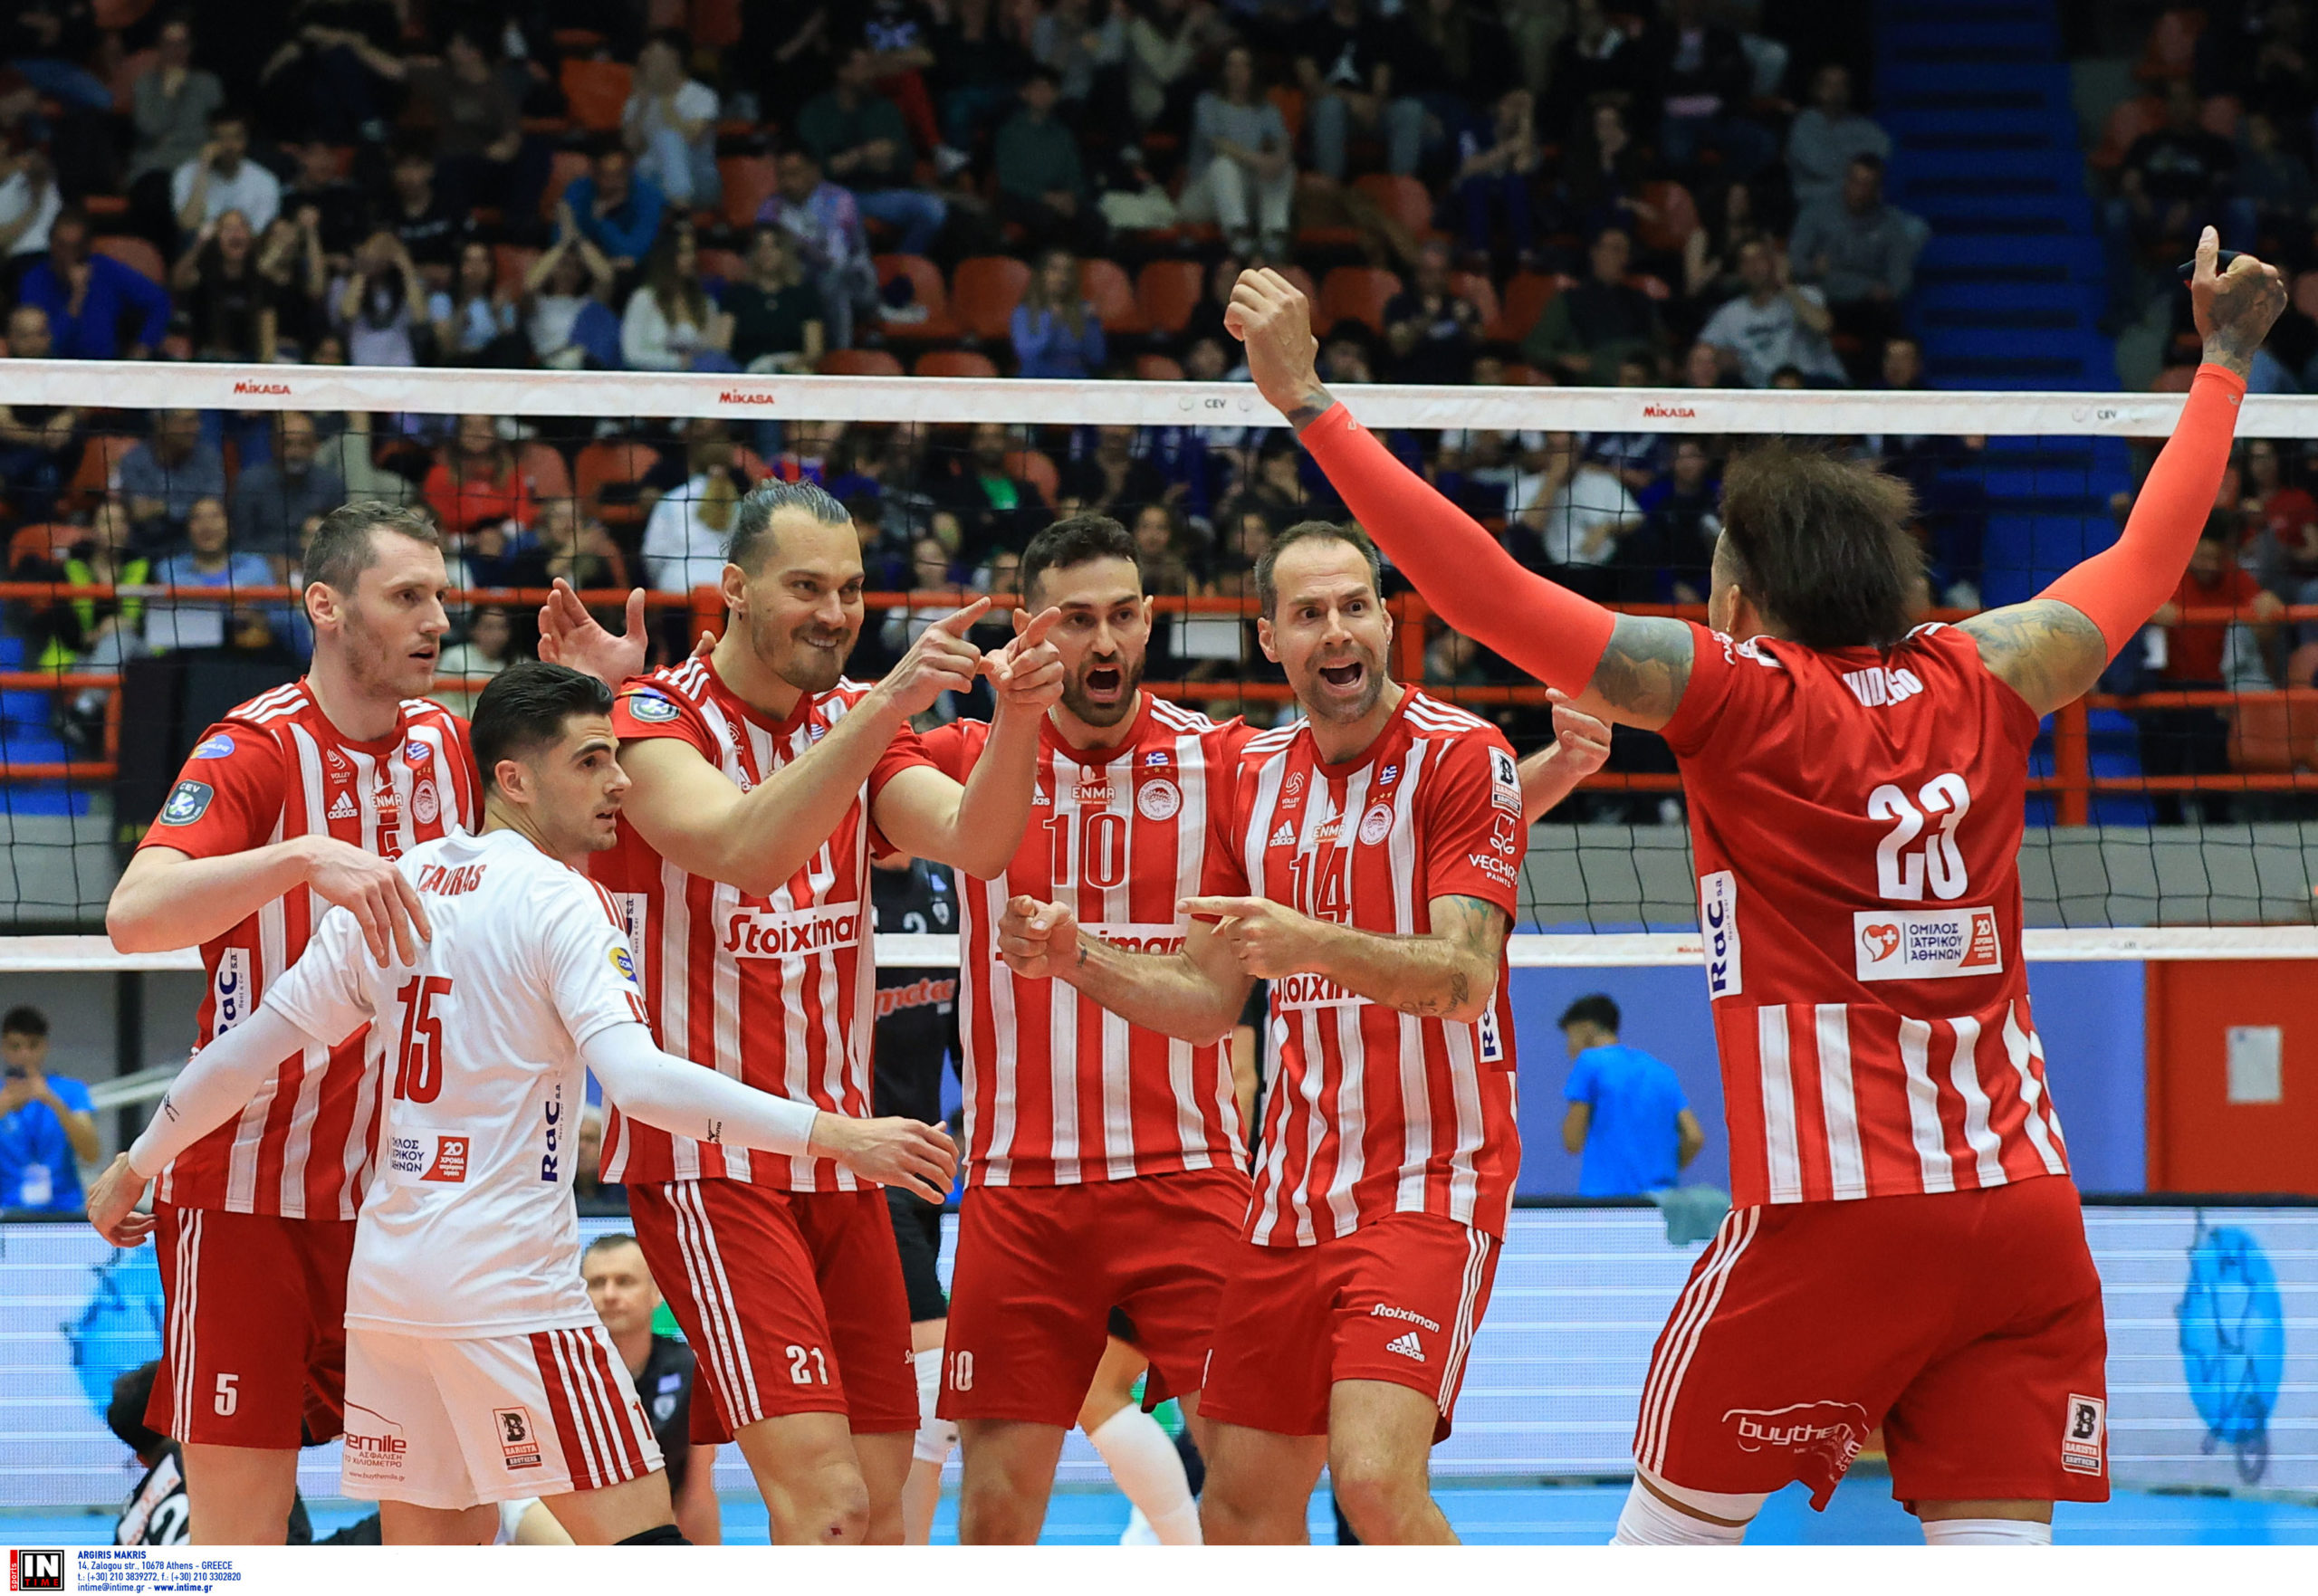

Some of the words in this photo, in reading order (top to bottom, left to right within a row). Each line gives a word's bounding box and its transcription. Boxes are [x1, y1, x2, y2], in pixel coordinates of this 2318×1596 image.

[1204, 398, 1226, 408] CEV
[179, 783, 200, 793] CEV
[371, 794, 403, 808] ENMA
[1071, 786, 1116, 799] ENMA
[328, 808, 358, 819] adidas
[1042, 811, 1129, 889] 10
[1269, 835, 1297, 847] adidas
[1867, 772, 1970, 901] 23
[1288, 845, 1352, 925] 14
[1486, 870, 1511, 889] PAINTS
[1707, 899, 1727, 993] RaC
[393, 974, 455, 1104] 15
[443, 1142, 465, 1157] 20
[541, 1101, 560, 1182] RaC
[1370, 1303, 1441, 1333] Stoiximan
[785, 1345, 829, 1385] 21
[1385, 1343, 1425, 1362] adidas
[215, 1373, 238, 1416] 5
[500, 1412, 526, 1442] B
[2072, 1402, 2096, 1439] B
